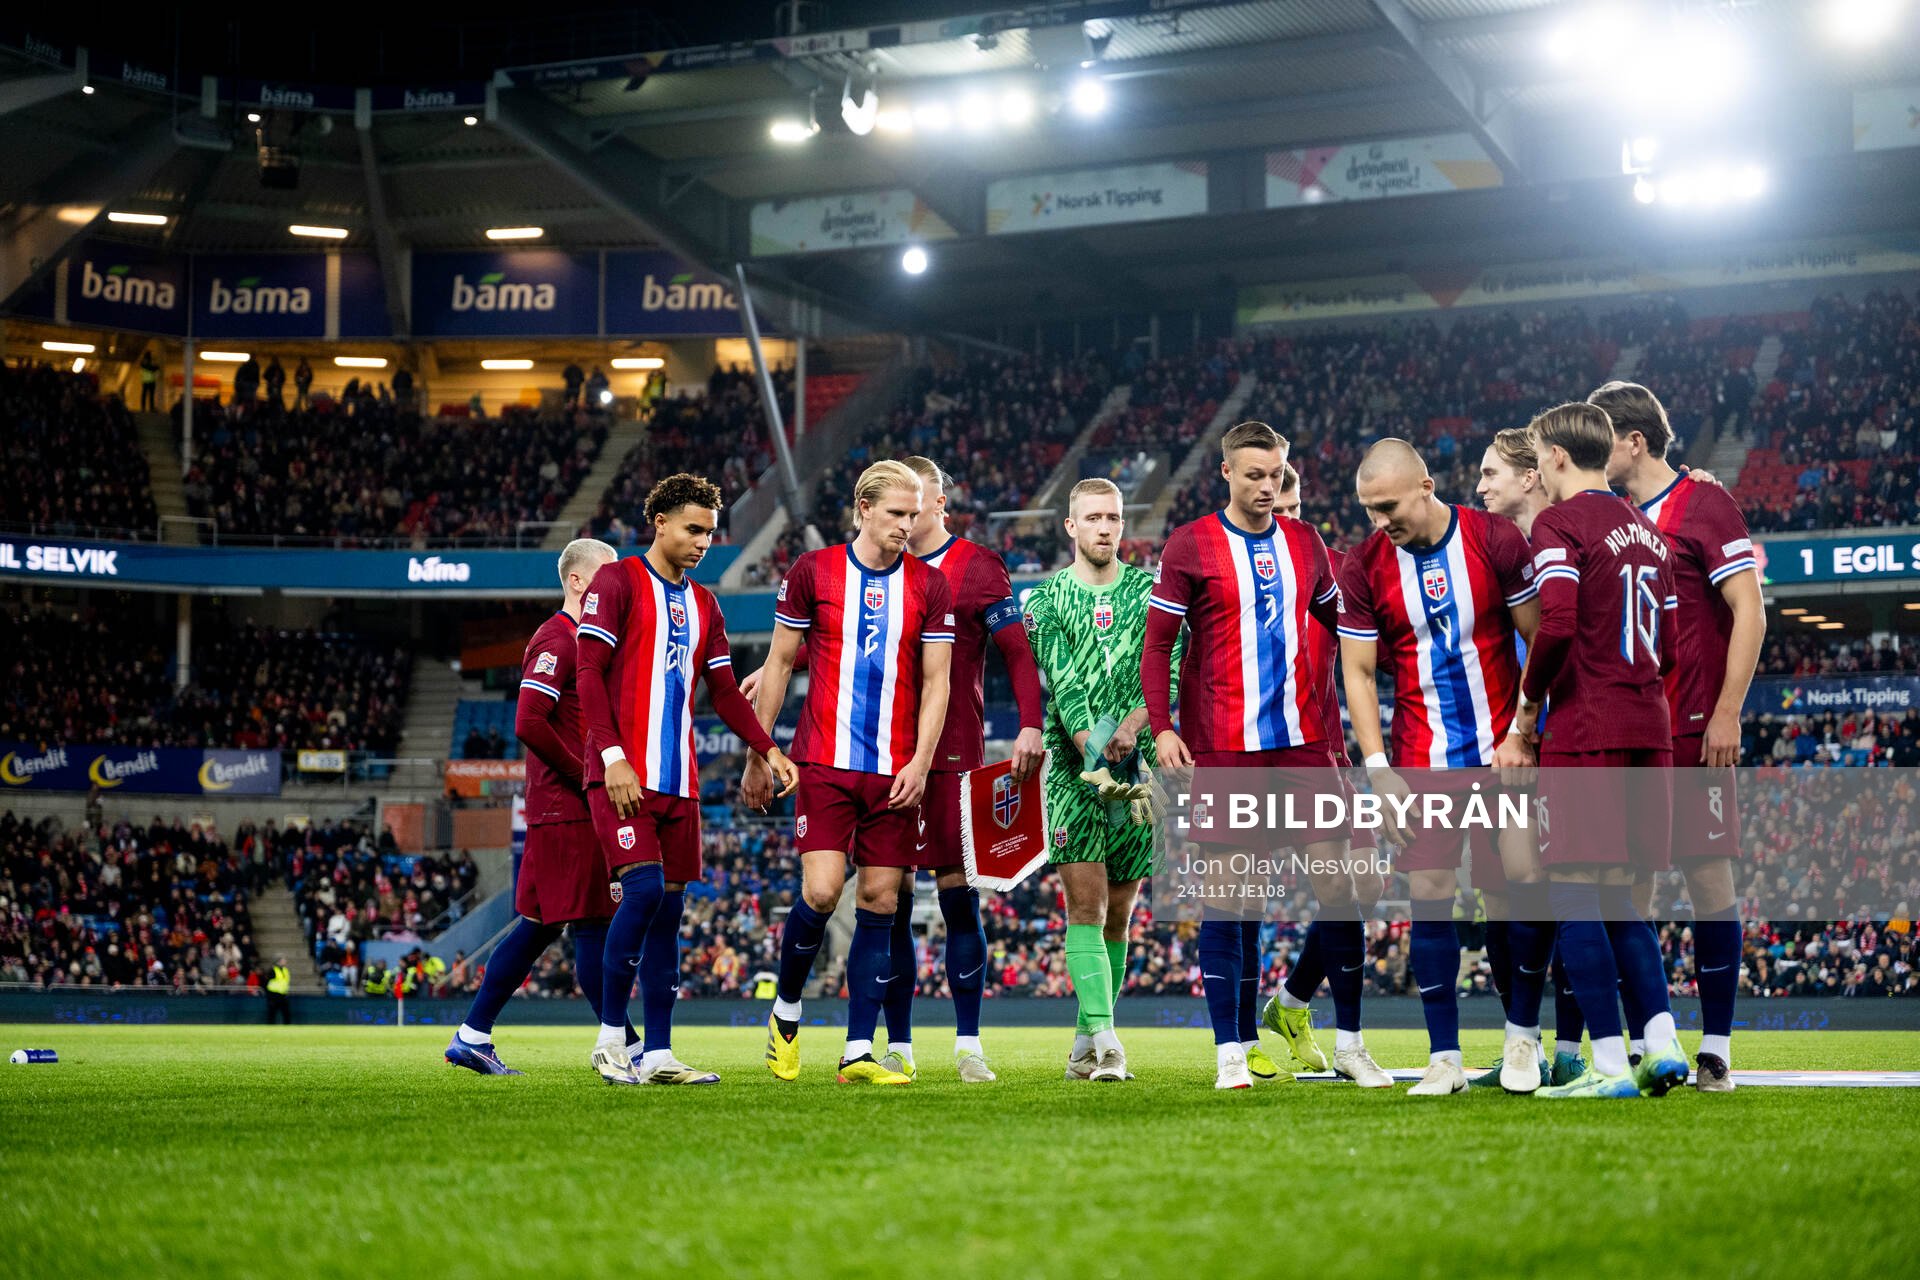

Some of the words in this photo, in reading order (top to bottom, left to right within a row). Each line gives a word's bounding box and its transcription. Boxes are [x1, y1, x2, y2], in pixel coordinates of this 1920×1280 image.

[1056, 194, 1102, 209] Norsk
[1104, 186, 1164, 207] Tipping
[81, 260, 176, 310] bama
[209, 278, 312, 315] bama
[451, 274, 556, 312] bama
[1604, 523, 1667, 562] HOLMGREN
[26, 545, 118, 575] SELVIK
[1800, 548, 1813, 575] 1
[1833, 545, 1905, 574] EGIL
[1264, 594, 1277, 630] 3
[864, 624, 880, 658] 2
[665, 641, 688, 679] 20
[1807, 687, 1852, 706] Norsk
[1853, 686, 1910, 707] Tipping
[13, 748, 68, 777] Bendit
[103, 750, 159, 780] Bendit
[213, 753, 269, 782] Bendit
[1708, 786, 1723, 824] 8
